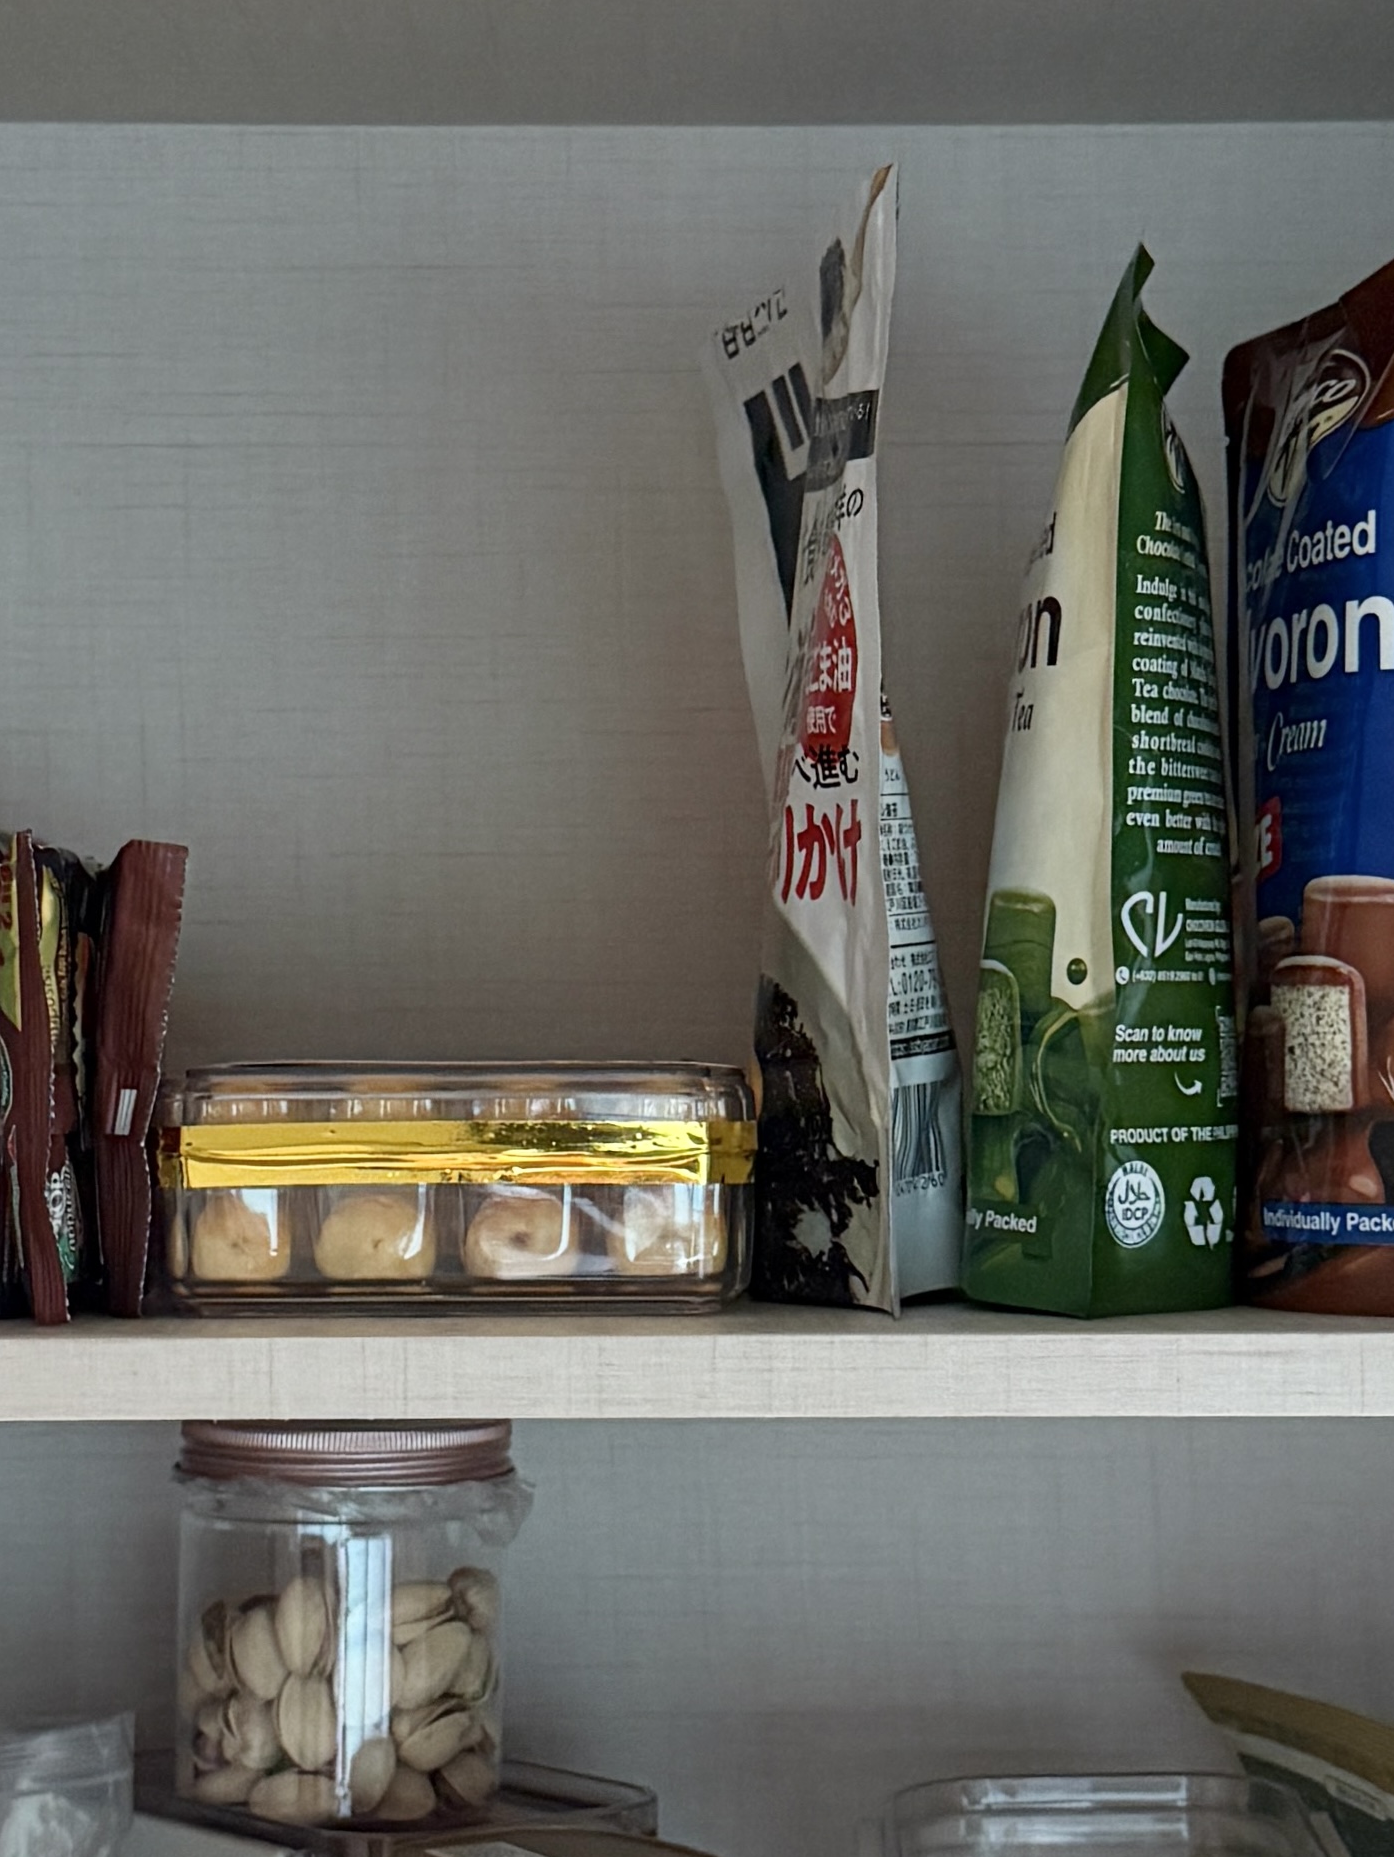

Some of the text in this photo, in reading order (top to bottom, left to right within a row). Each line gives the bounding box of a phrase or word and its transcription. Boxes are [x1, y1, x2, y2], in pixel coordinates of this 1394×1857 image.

[1285, 509, 1377, 570] Coated
[1132, 678, 1159, 698] Tea
[1131, 703, 1169, 725] blend
[1266, 710, 1328, 772] Cream
[1128, 755, 1156, 776] the
[1126, 810, 1160, 827] even
[1115, 1024, 1203, 1043] Scan to know
[1113, 1044, 1206, 1063] more about us
[1110, 1126, 1170, 1144] PRODUCT
[1171, 1126, 1188, 1142] OF
[1190, 1126, 1212, 1142] THE
[985, 1210, 1039, 1234] Packed
[1122, 1207, 1149, 1222] IDCP
[1263, 1206, 1342, 1237] Individually
